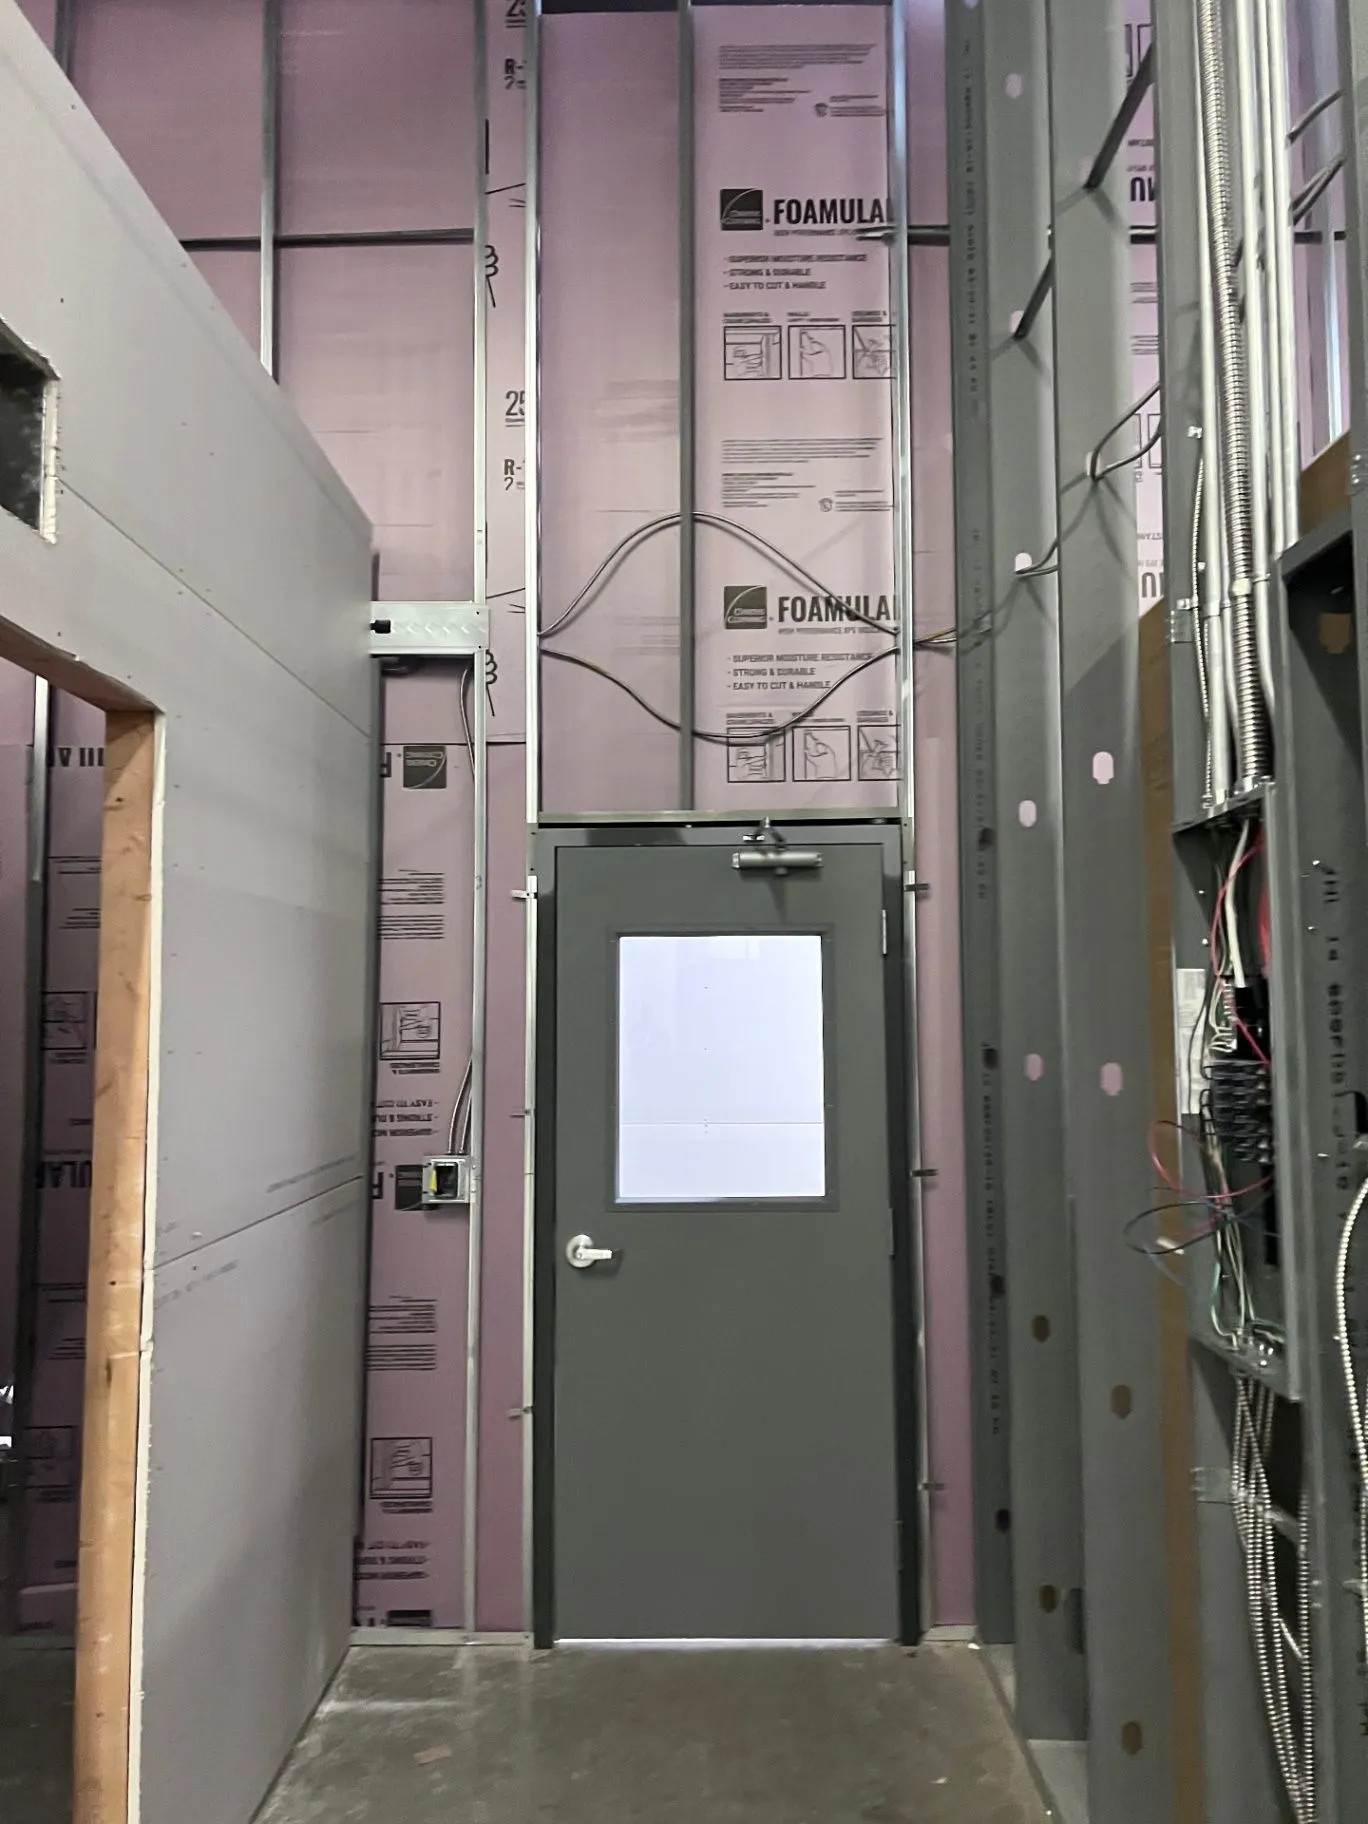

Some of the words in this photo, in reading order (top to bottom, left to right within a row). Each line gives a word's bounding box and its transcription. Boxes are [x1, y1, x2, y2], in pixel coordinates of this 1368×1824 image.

[774, 198, 888, 224] FOAMULA
[778, 595, 897, 622] FOAMULA
[733, 682, 754, 690] EASY
[756, 682, 768, 690] TO
[770, 682, 786, 690] CUT
